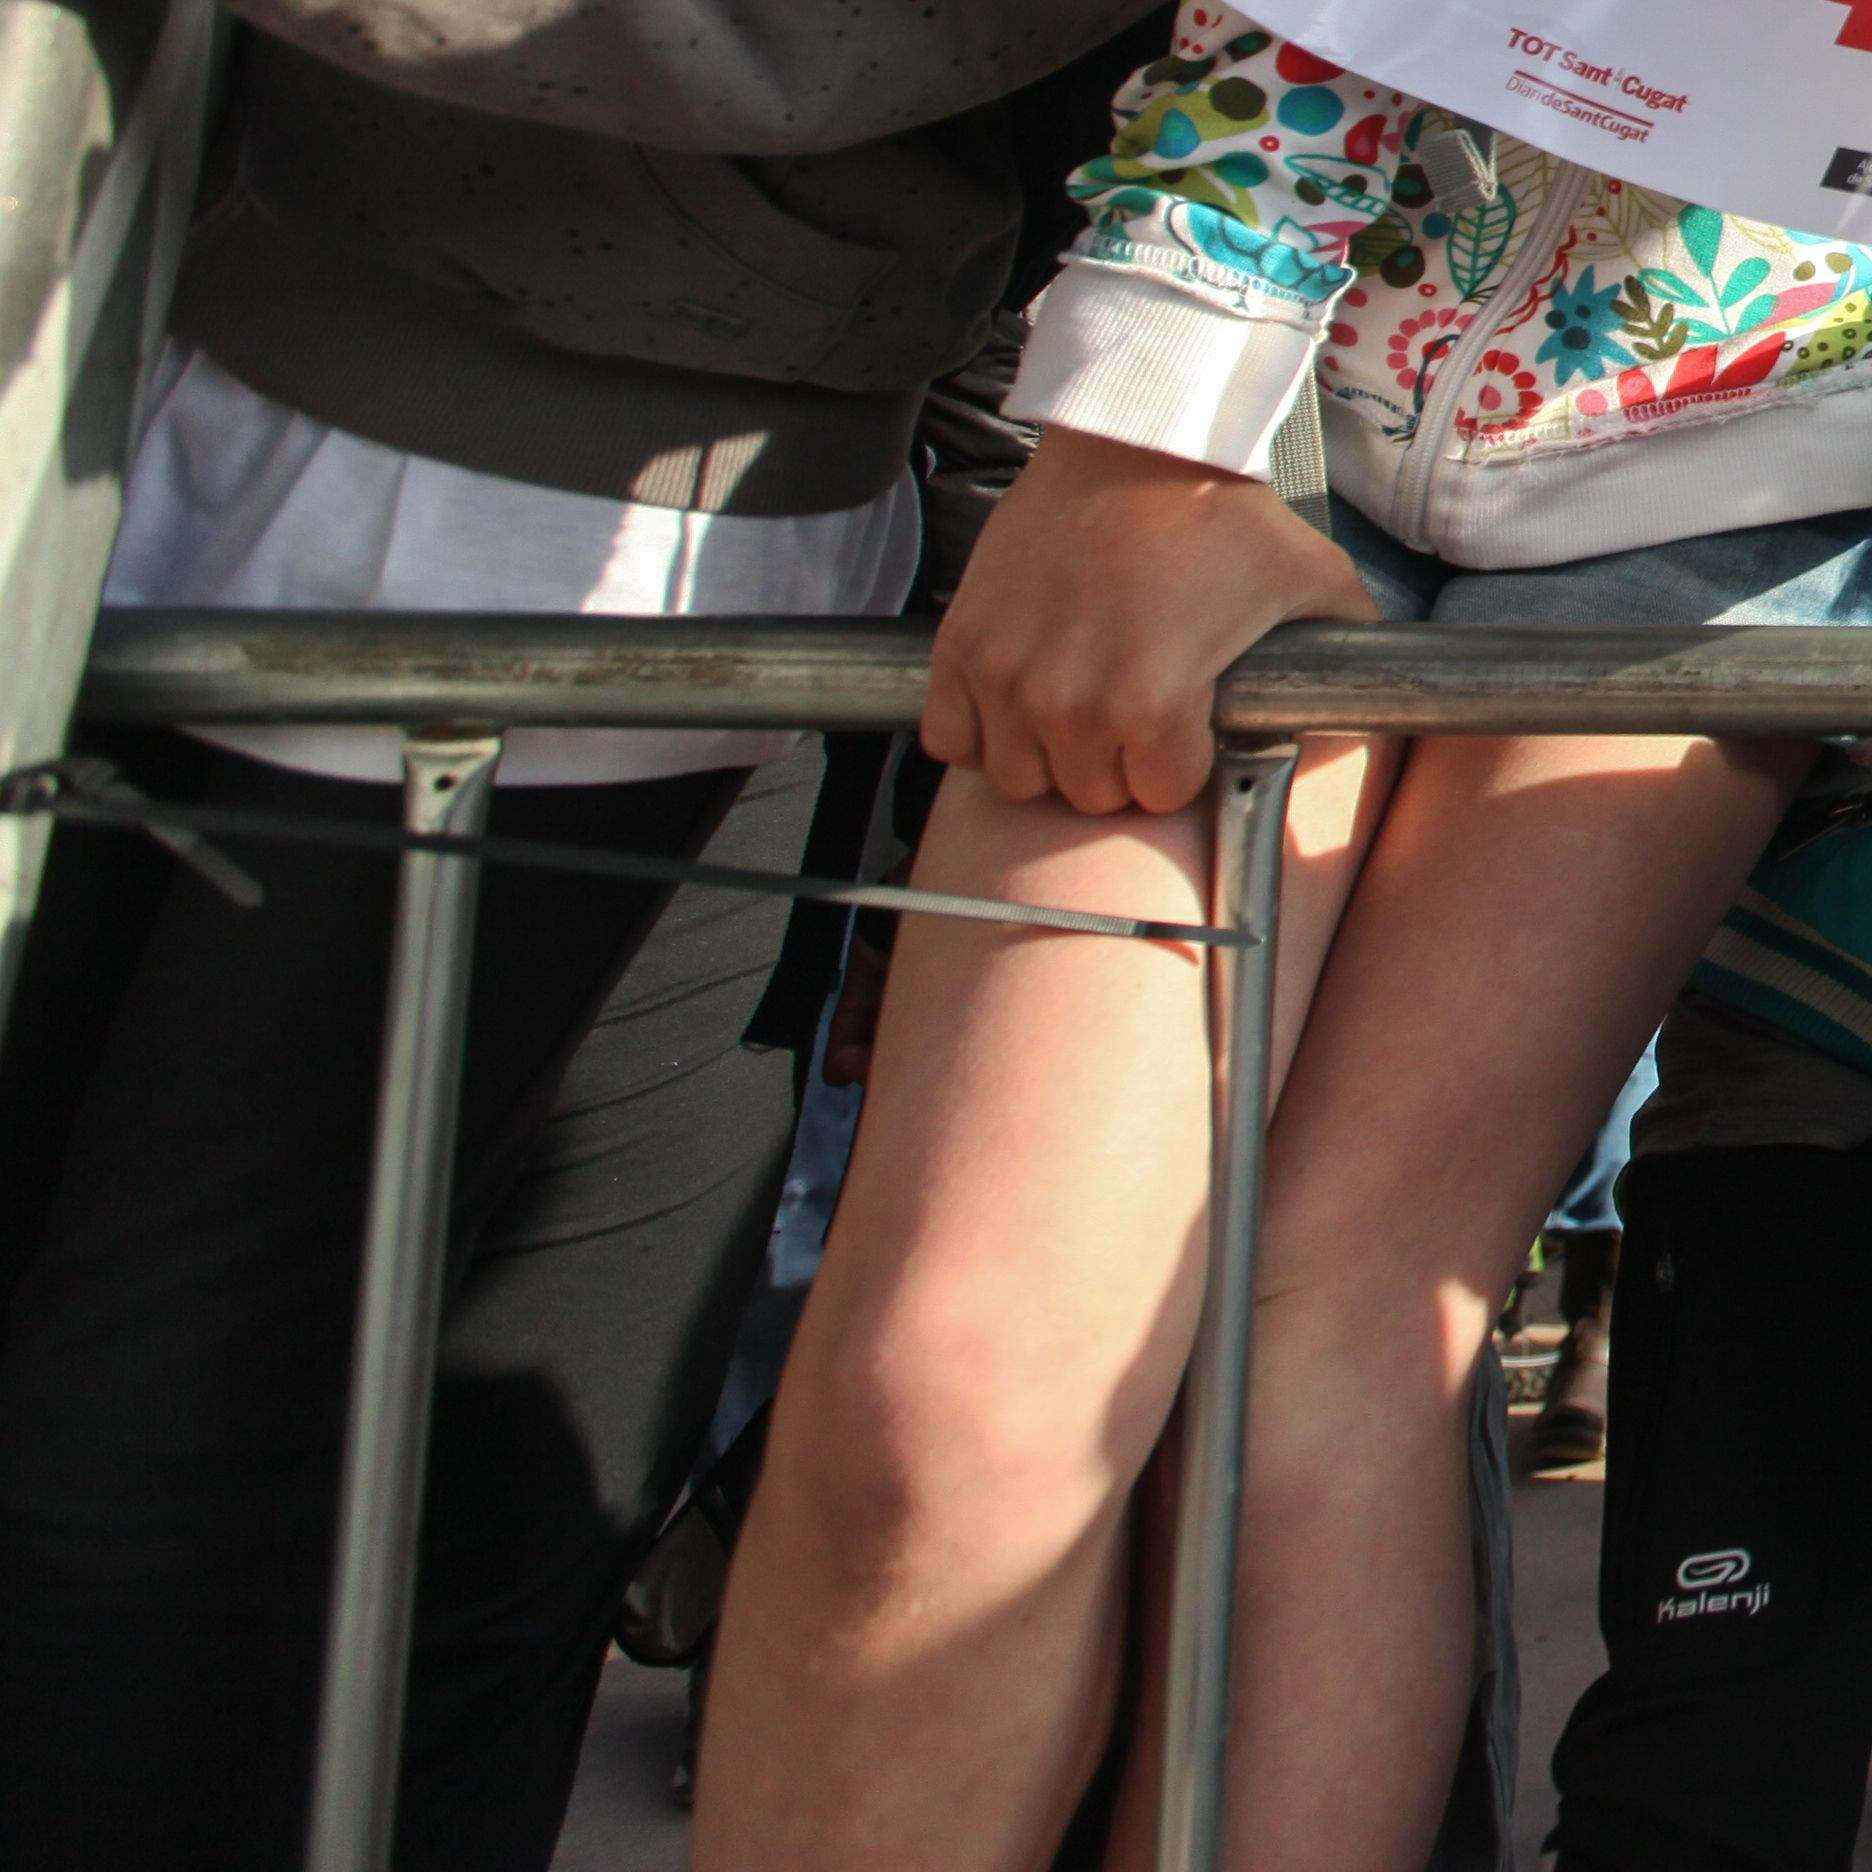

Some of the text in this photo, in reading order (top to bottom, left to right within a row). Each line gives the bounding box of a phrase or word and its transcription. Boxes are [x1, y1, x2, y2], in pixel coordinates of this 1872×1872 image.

[1507, 27, 1688, 113] TOT Sant Cugat
[1657, 1582, 1770, 1624] Kalenji
